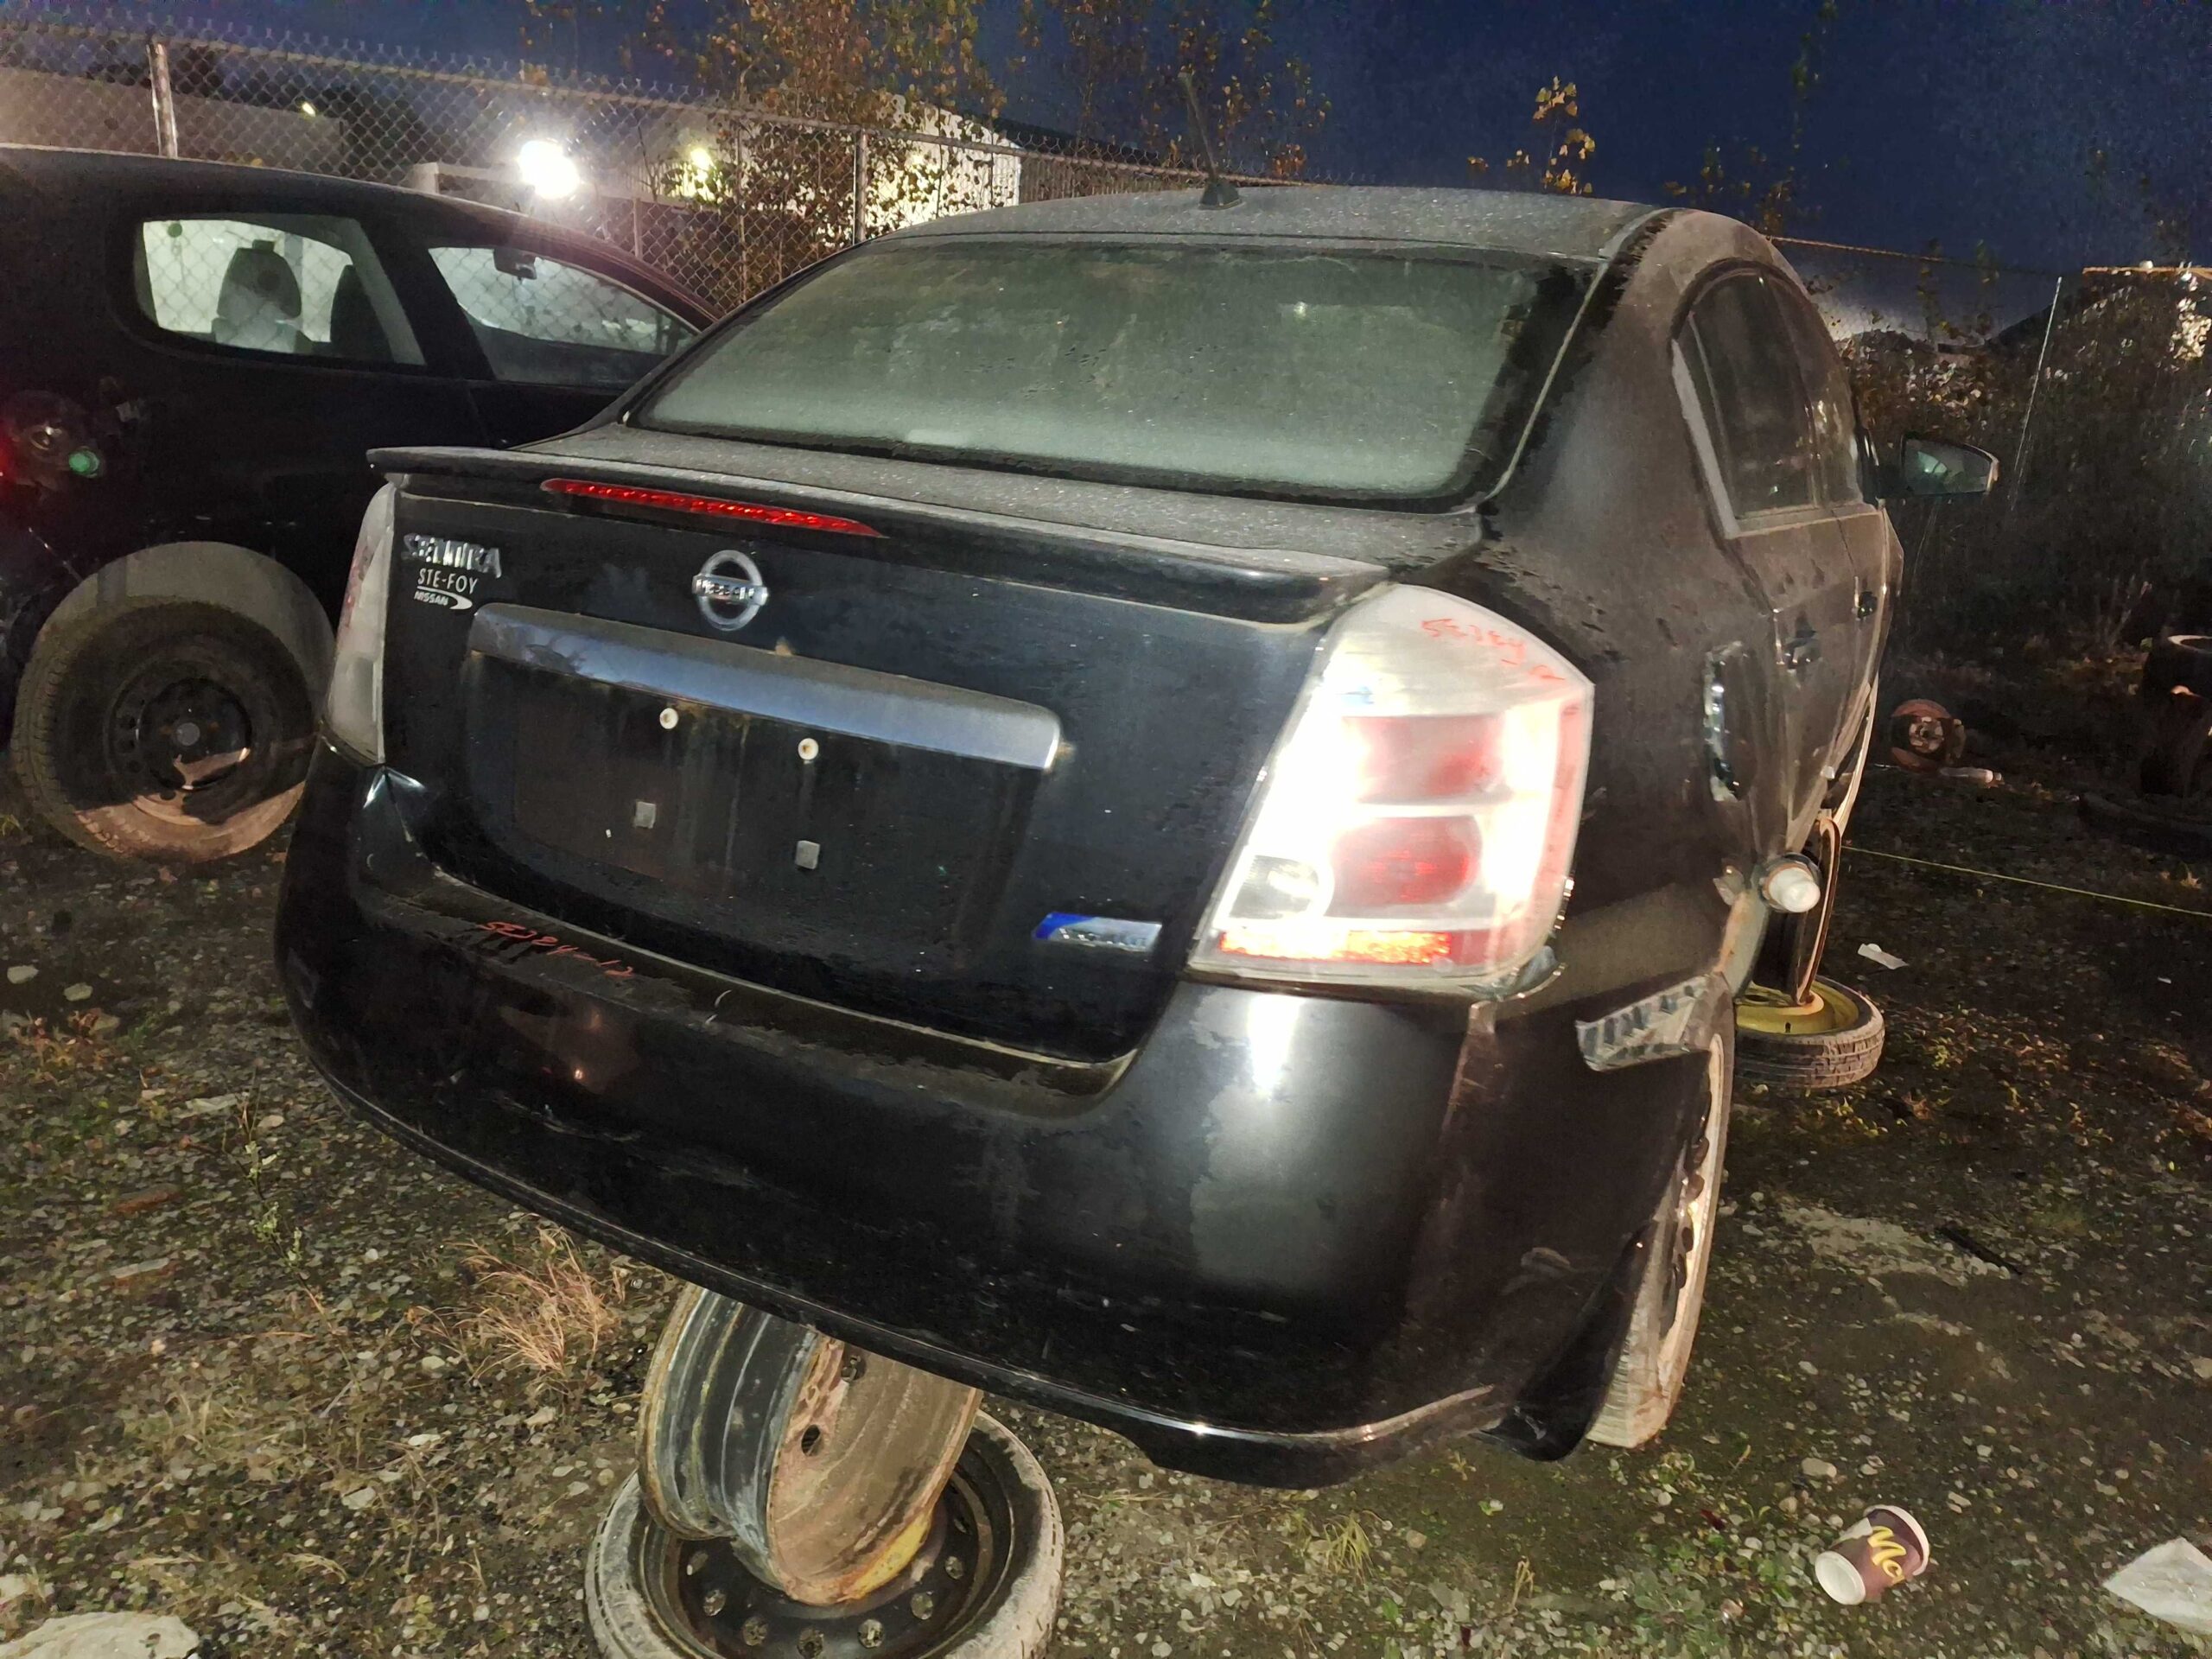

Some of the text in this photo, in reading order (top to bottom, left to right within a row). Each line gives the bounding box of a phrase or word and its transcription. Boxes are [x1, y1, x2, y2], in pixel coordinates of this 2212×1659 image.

[417, 568, 478, 594] STE-FOY
[414, 590, 449, 606] NISSAN
[1867, 1525, 1906, 1585] Mc
